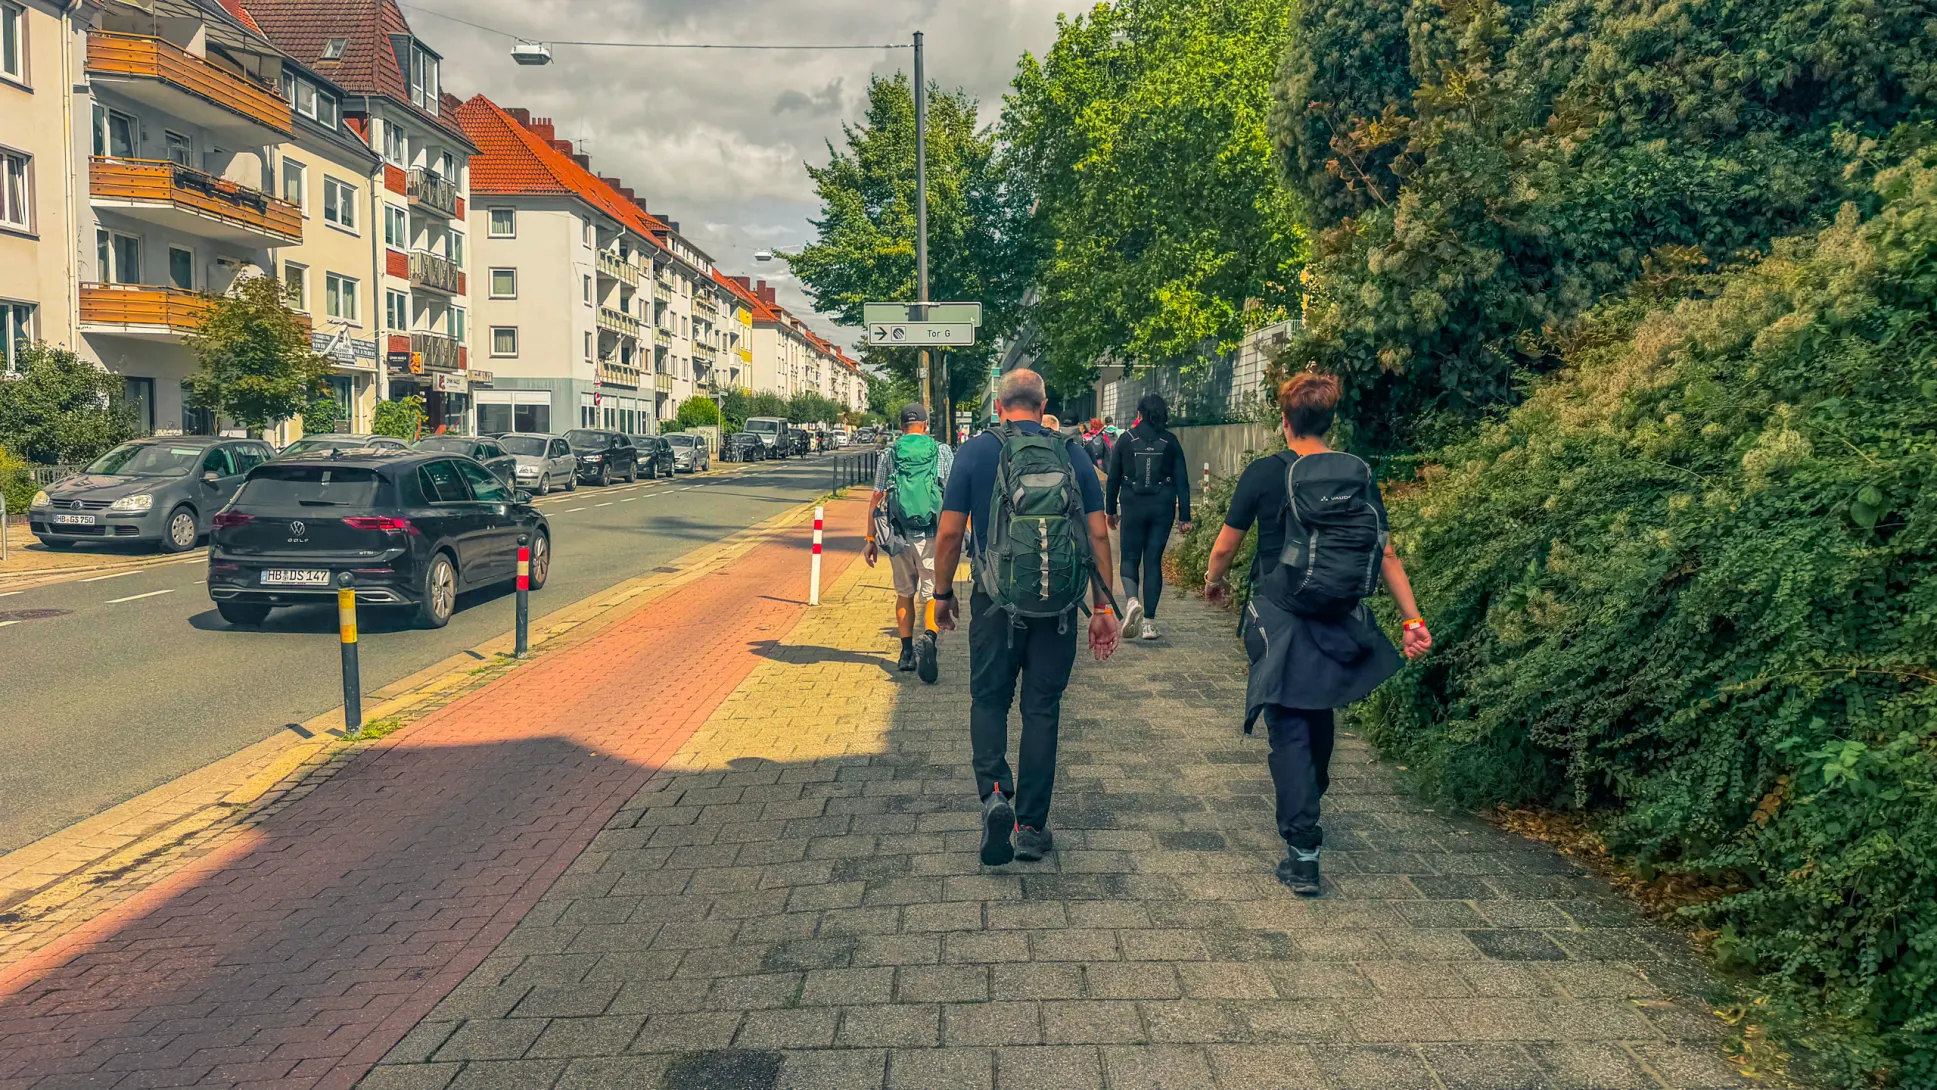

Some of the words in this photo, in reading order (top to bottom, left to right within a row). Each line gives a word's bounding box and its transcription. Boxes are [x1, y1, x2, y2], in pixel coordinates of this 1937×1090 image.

[927, 329, 940, 338] Tor
[944, 329, 951, 338] G
[57, 515, 66, 523] HB
[80, 516, 94, 524] 750
[268, 569, 282, 581] HB
[289, 570, 304, 581] DS
[306, 570, 328, 581] 147
